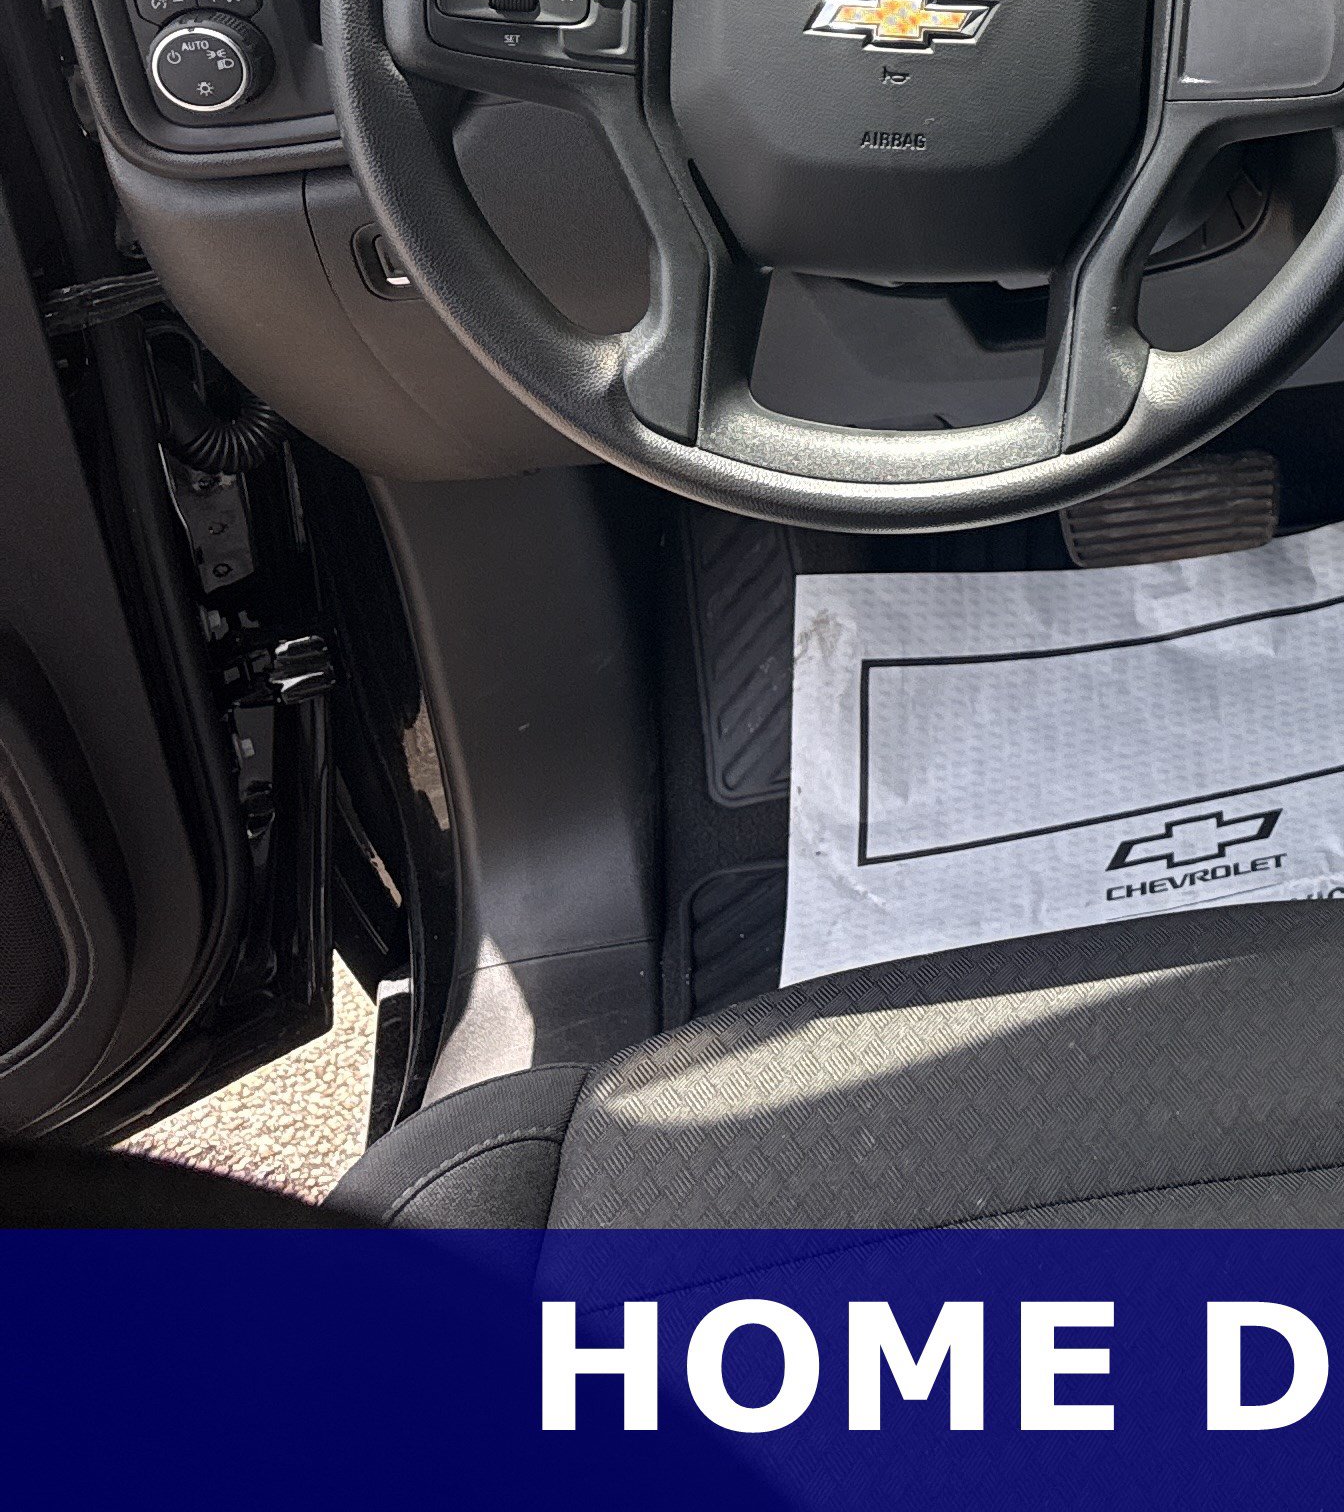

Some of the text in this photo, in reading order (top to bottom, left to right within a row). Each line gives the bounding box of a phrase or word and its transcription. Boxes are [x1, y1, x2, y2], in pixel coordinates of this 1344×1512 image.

[181, 40, 209, 51] AUTO
[503, 34, 520, 43] SET
[860, 131, 927, 151] AIRBAG
[1106, 853, 1288, 901] CHEVROLET
